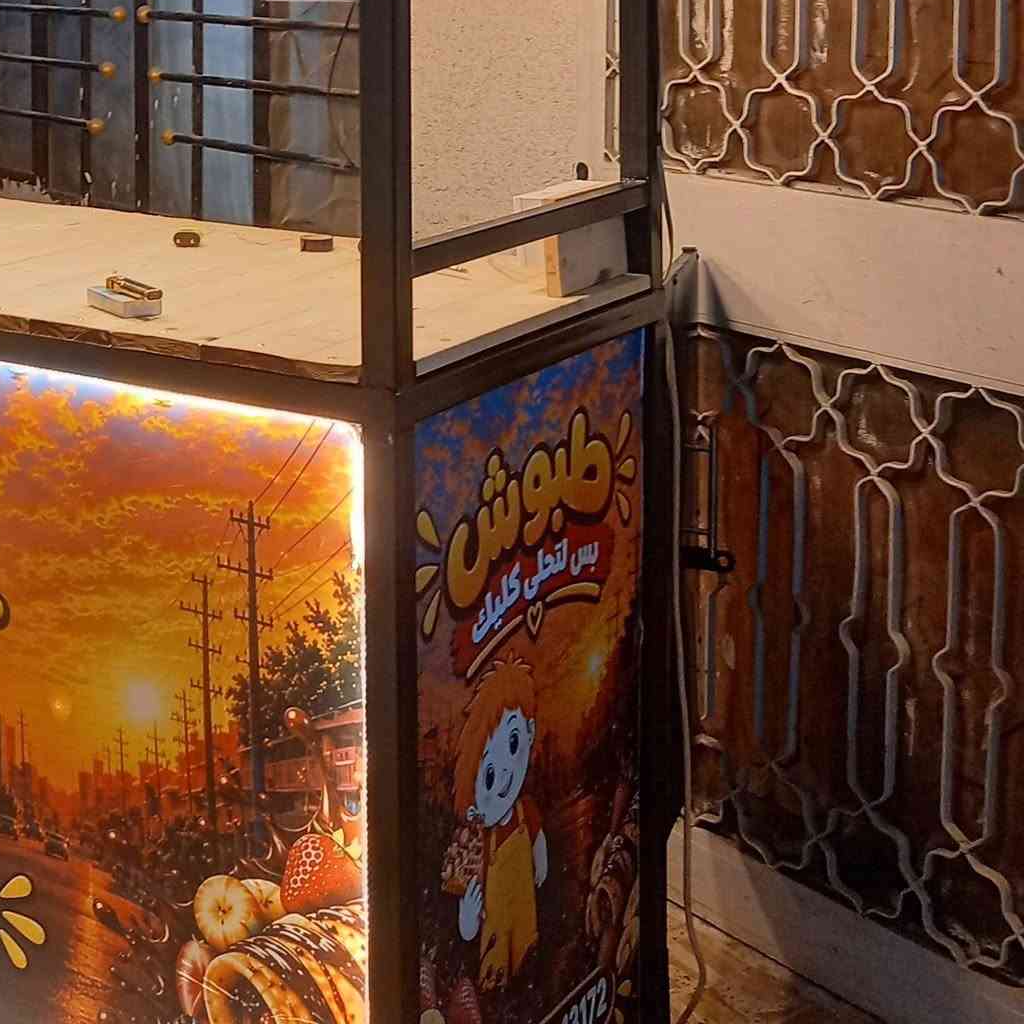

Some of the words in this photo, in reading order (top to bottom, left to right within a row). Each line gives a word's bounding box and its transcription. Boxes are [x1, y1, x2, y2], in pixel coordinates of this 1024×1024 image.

[445, 405, 616, 616] طبوش
[570, 541, 599, 576] بس
[471, 561, 522, 644] كليك
